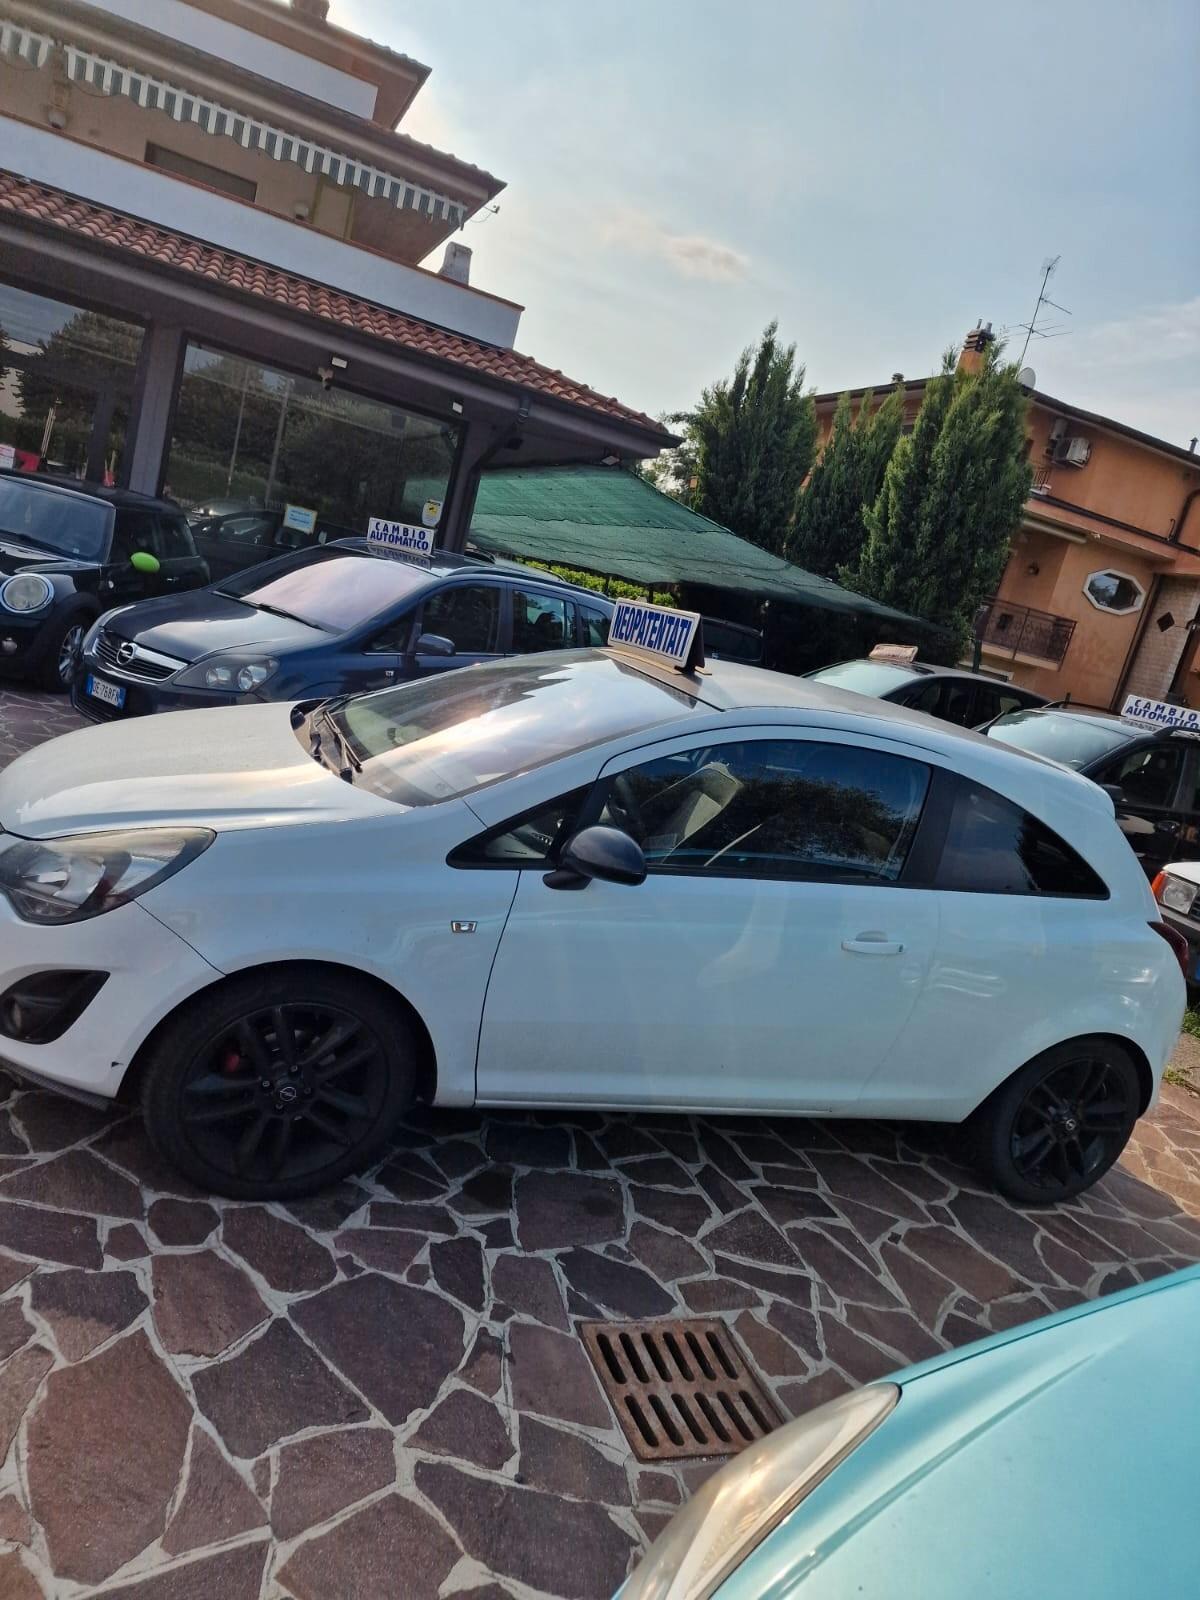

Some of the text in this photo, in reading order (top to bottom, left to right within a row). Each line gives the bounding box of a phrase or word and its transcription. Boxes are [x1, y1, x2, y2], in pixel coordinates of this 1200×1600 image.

[370, 530, 429, 550] AUTOMATICO
[375, 522, 426, 540] CAMBIO
[612, 605, 692, 657] NEOPATENTATI
[1134, 699, 1198, 722] CAMBIO
